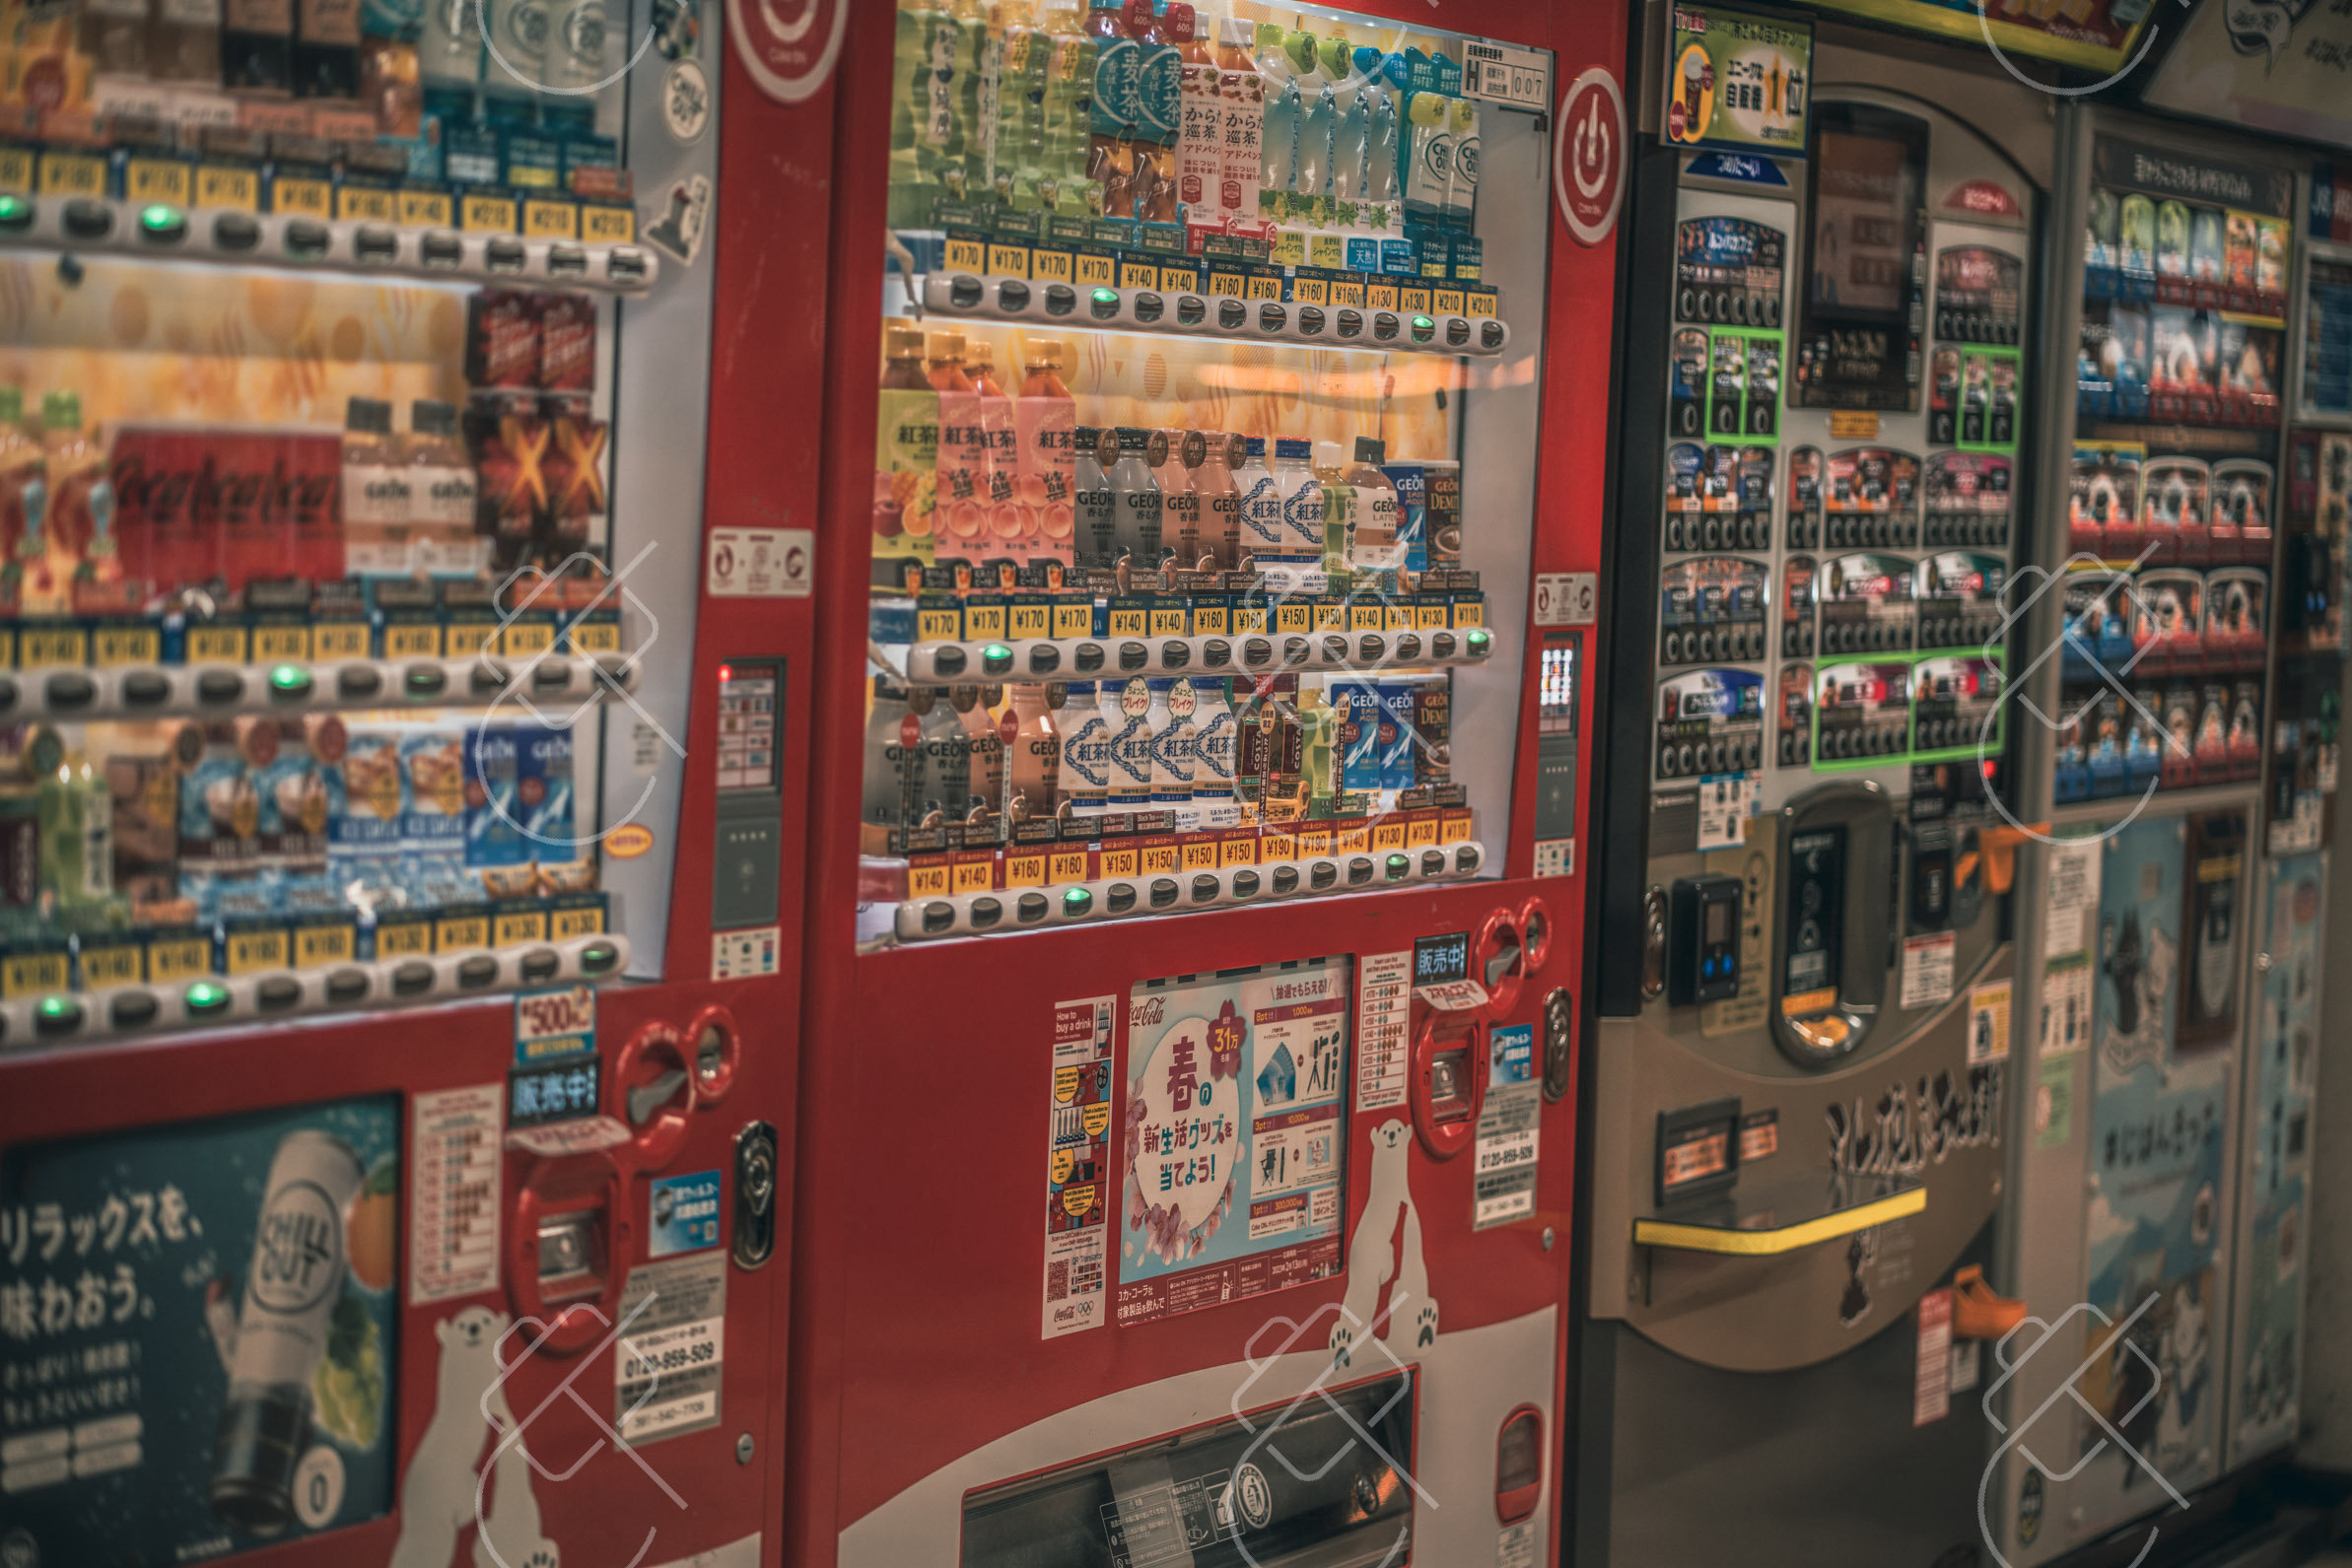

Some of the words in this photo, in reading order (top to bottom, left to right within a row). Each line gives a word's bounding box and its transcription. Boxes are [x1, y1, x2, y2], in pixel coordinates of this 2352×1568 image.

[1118, 49, 1140, 118] 麦茶
[1465, 59, 1480, 92] H
[1513, 75, 1543, 96] 007
[1149, 65, 1160, 111] 香ばしい
[1160, 56, 1181, 123] 麦茶
[1725, 82, 1764, 111] 自販機
[1225, 165, 1257, 173] 体についた
[950, 243, 979, 267] ¥170
[995, 248, 1024, 271] ¥170
[1039, 253, 1068, 276] ¥170
[1082, 258, 1109, 280] ¥170
[1127, 267, 1152, 288] ¥140
[1167, 271, 1192, 292] ¥140
[1215, 276, 1239, 297] ¥160
[1253, 280, 1277, 300] ¥160
[1299, 282, 1322, 302] ¥160
[1335, 286, 1358, 305] ¥160
[1370, 290, 1392, 307] ¥130
[1405, 293, 1425, 310] ¥130
[1437, 294, 1460, 312] ¥210
[1472, 297, 1493, 315] ¥210
[972, 610, 1001, 630] ¥170
[1016, 609, 1045, 630] ¥170
[1060, 608, 1087, 629] ¥170
[1115, 613, 1141, 632] ¥140
[1155, 612, 1181, 632] ¥140
[1199, 610, 1222, 629] ¥160
[1238, 611, 1263, 630] ¥160
[1281, 607, 1305, 627] ¥150
[1318, 607, 1342, 626] ¥150
[1355, 608, 1378, 627] ¥140
[1421, 608, 1443, 626] ¥130
[1458, 605, 1479, 623] ¥110
[924, 615, 954, 635] ¥170
[1127, 686, 1145, 697] ちょっと
[1173, 688, 1193, 700] ちょっと
[1123, 696, 1147, 711] ブレイク!
[1170, 699, 1194, 712] ブレイク!
[1263, 719, 1273, 729] 限定
[1254, 729, 1263, 772] COSTA
[1294, 727, 1303, 770] COSTA
[1137, 814, 1148, 824] Black
[1378, 826, 1401, 846] ¥130
[1412, 823, 1433, 842] ¥130
[1446, 821, 1467, 839] ¥110
[1266, 837, 1290, 856] ¥190
[1303, 833, 1326, 852] ¥190
[1342, 831, 1364, 850] ¥140
[1146, 850, 1173, 870] ¥150
[1187, 846, 1212, 866] ¥150
[1226, 842, 1250, 862] ¥150
[1012, 859, 1040, 879] ¥160
[1056, 855, 1082, 875] ¥160
[1105, 853, 1133, 874] ¥150
[916, 870, 943, 891] ¥140
[959, 866, 987, 887] ¥140
[1418, 945, 1462, 976] 販売中
[1276, 979, 1327, 1000] 抽選でもらえる!
[1056, 1022, 1068, 1034] buy
[1074, 1018, 1092, 1031] drink
[1057, 1012, 1069, 1022] How
[1070, 1011, 1076, 1020] to
[1256, 1011, 1269, 1022] 8pt
[1213, 1027, 1239, 1054] 31万
[1166, 1036, 1212, 1112] 春の
[512, 1067, 588, 1118] 販売中
[1143, 1113, 1233, 1156] 新生活グッズを
[1255, 1122, 1267, 1131] 3pt
[1159, 1153, 1216, 1193] 当てよう!
[1253, 1205, 1264, 1216] 1pt
[1, 1182, 203, 1264] リラックスを、
[2, 1263, 156, 1340] 味わおう。
[1117, 1297, 1165, 1320] 対象製品を飲んで
